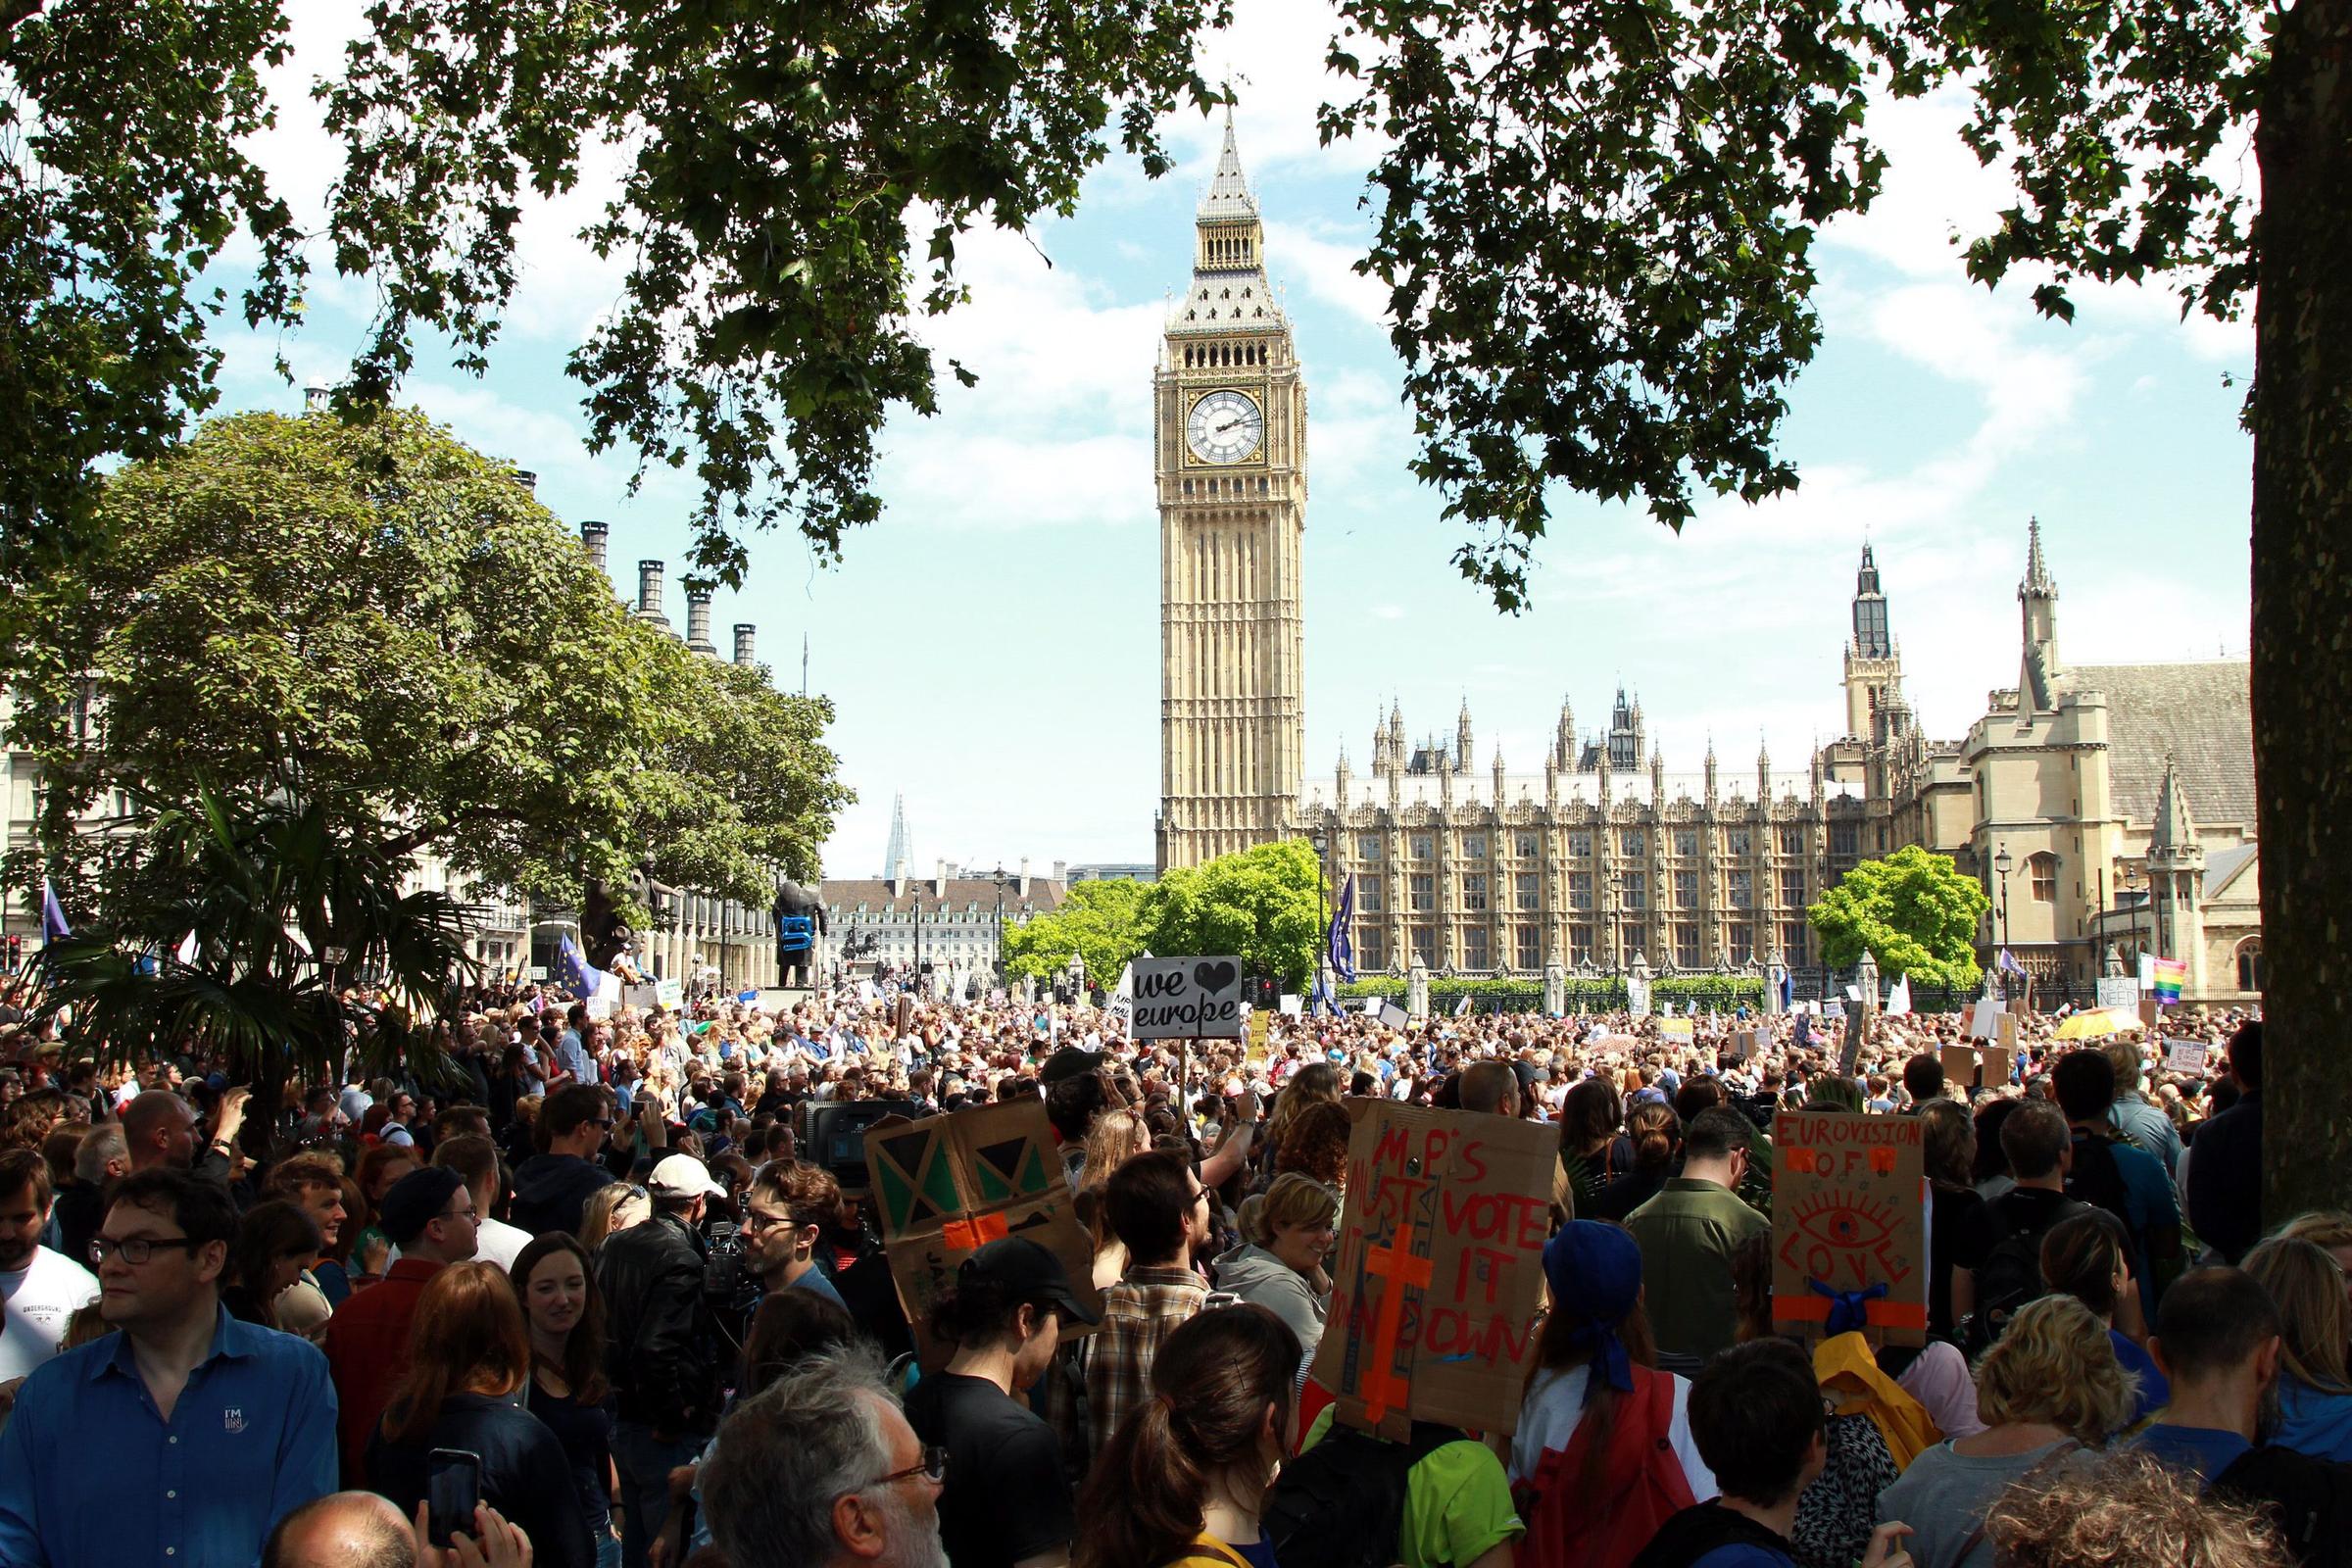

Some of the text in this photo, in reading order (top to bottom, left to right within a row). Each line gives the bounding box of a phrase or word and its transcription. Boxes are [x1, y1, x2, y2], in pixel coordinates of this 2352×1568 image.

[1134, 971, 1187, 1000] we
[2099, 991, 2136, 1006] NEED
[1134, 993, 1237, 1037] europe
[1776, 1116, 1921, 1147] EUROVISION
[1815, 1151, 1862, 1177] OF
[1443, 1190, 1548, 1250] VOTE
[1454, 1247, 1517, 1303] IT
[1779, 1231, 1910, 1286] LOVE
